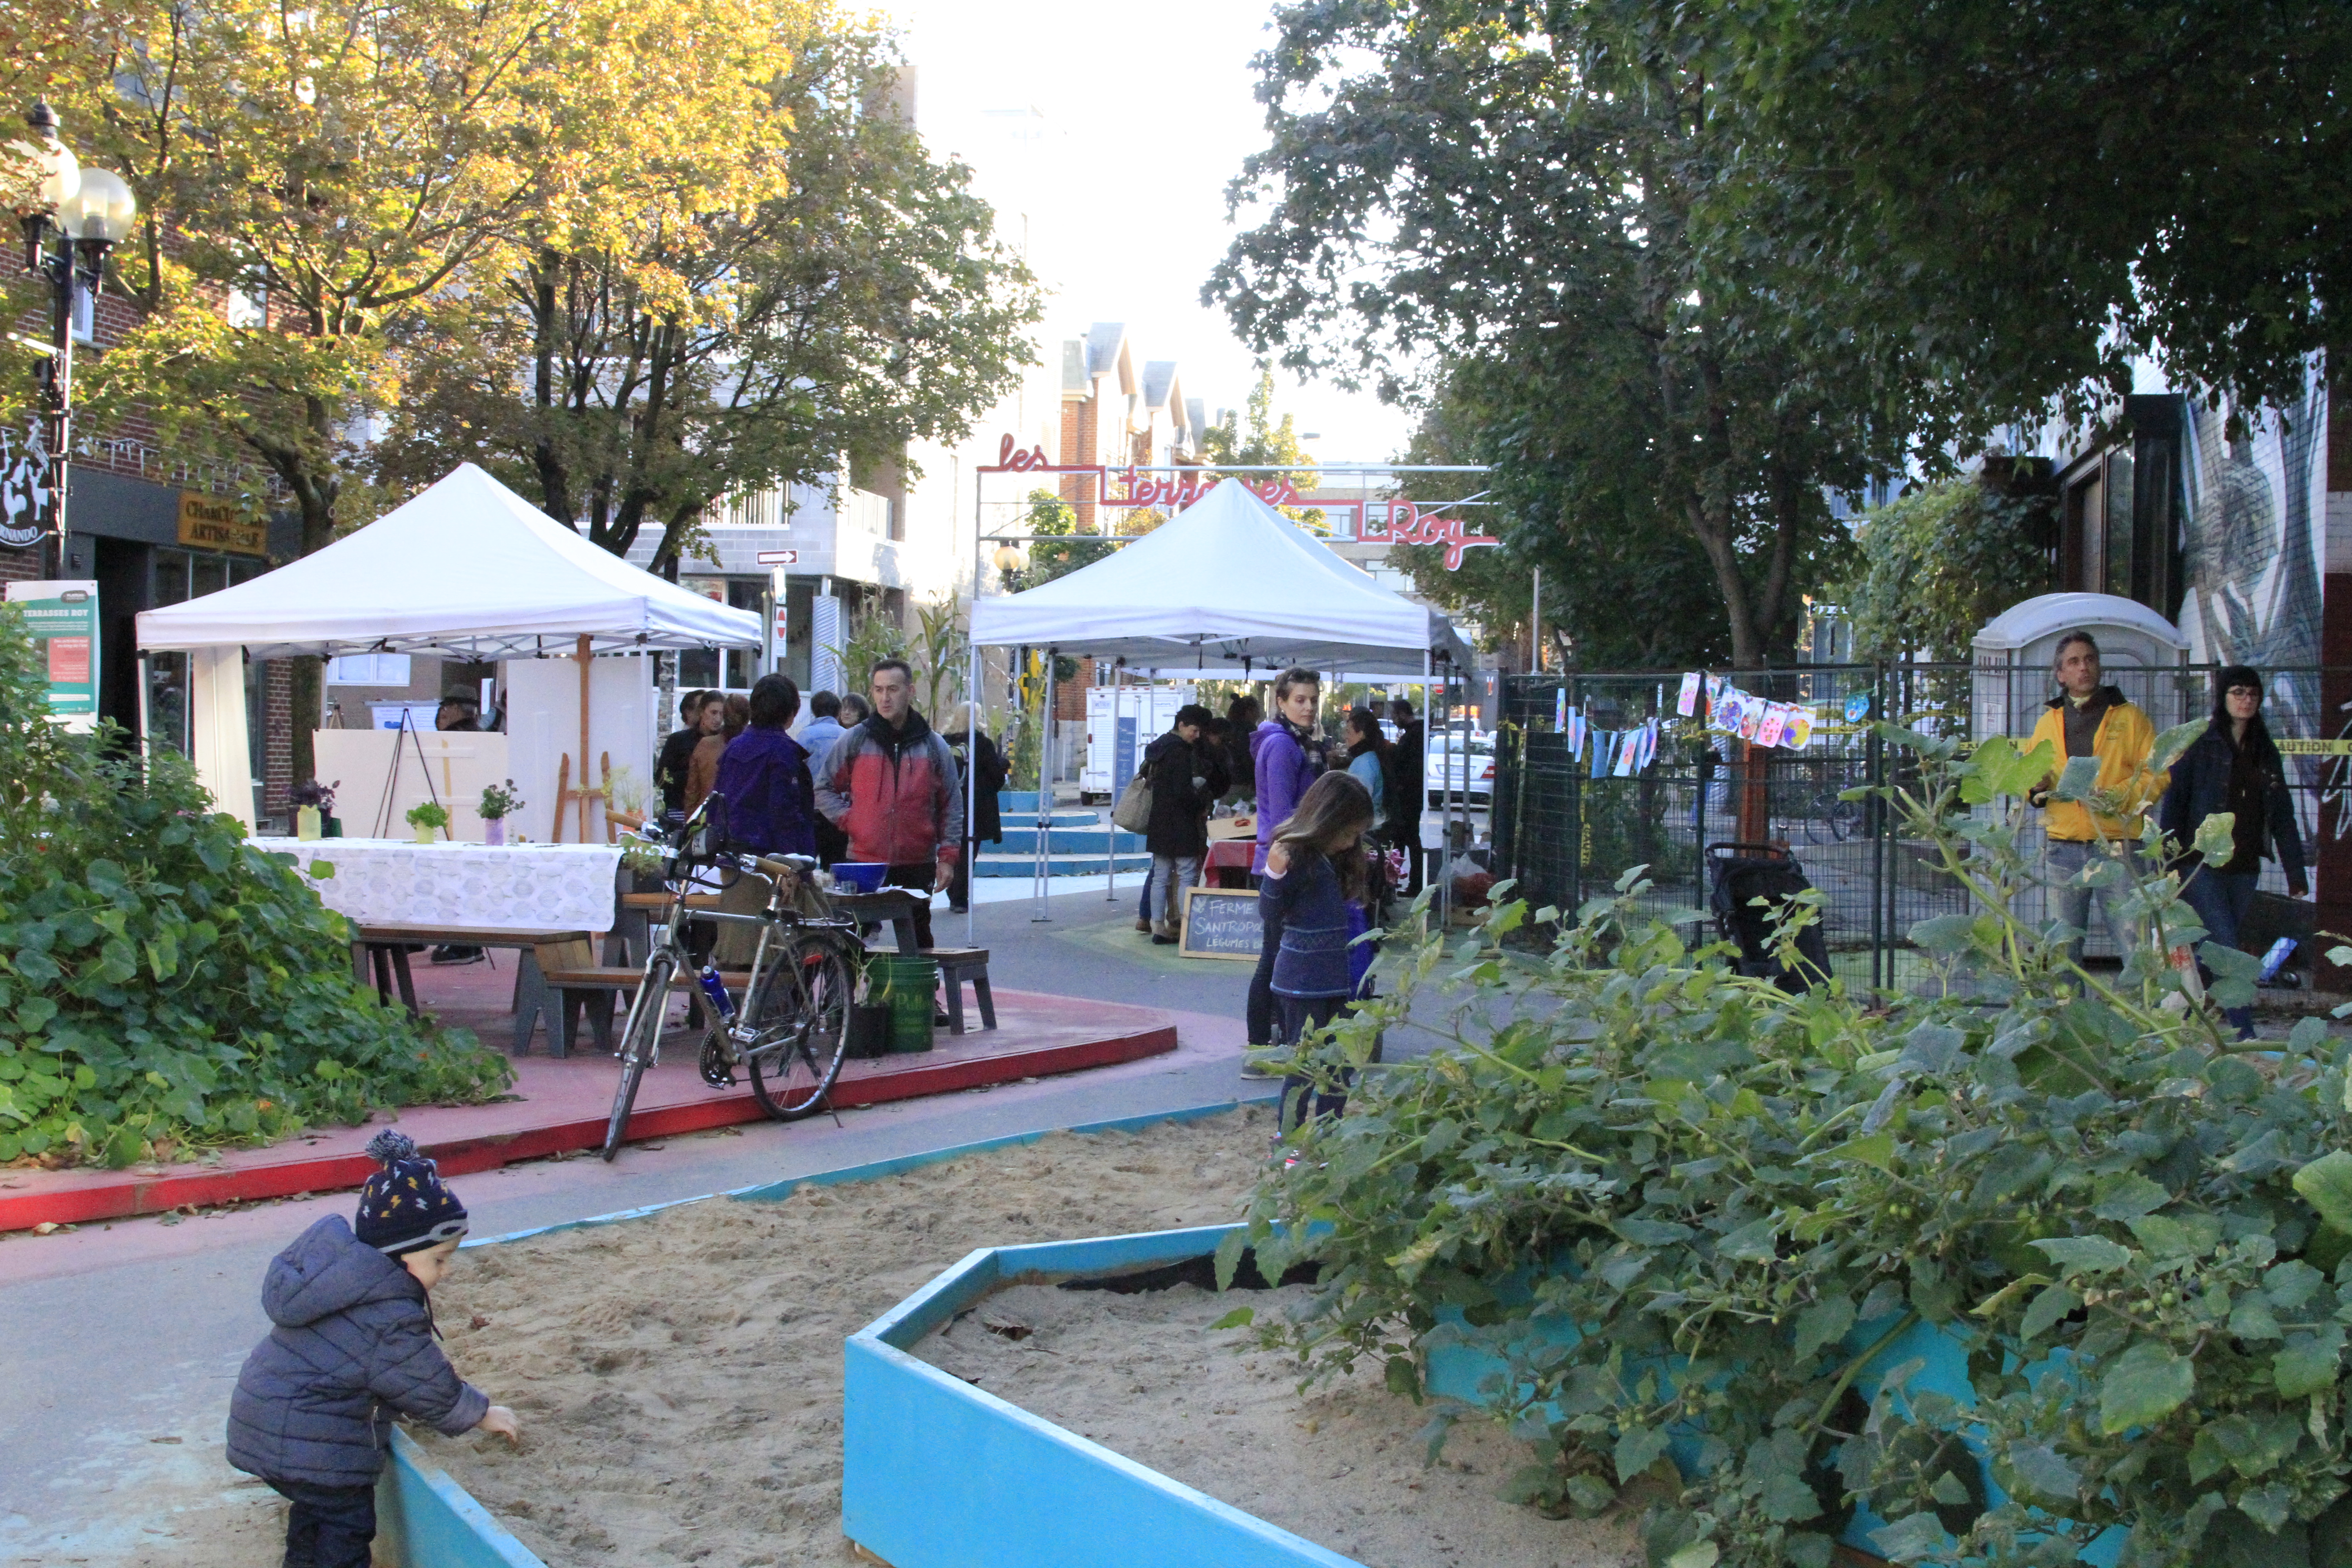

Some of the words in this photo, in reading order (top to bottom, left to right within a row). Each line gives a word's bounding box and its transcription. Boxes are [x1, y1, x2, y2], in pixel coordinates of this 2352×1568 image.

[999, 432, 1049, 472] les
[1118, 465, 1300, 507] terrses
[1387, 499, 1468, 571] Roy
[2278, 742, 2332, 752] AUTION
[1210, 900, 1254, 916] FERME
[1206, 935, 1249, 948] LÉGUMES
